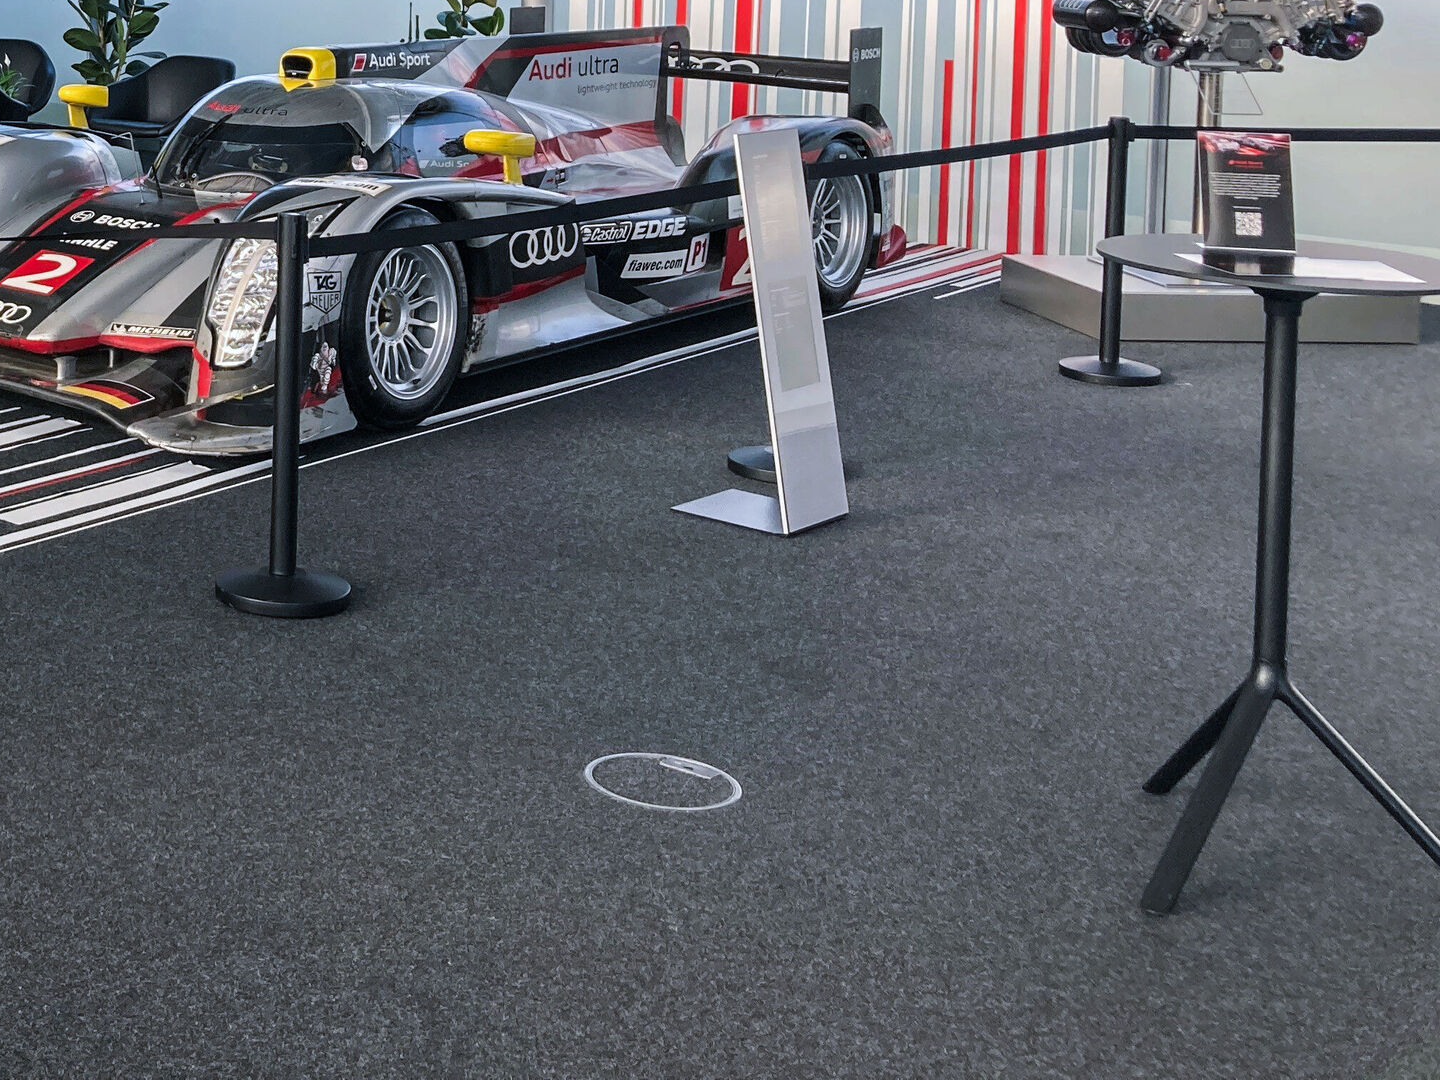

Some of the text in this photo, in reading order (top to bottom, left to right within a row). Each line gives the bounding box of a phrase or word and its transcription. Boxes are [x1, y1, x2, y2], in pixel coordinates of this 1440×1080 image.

[369, 52, 431, 69] Audi Sport
[861, 48, 880, 60] BOSCH
[528, 55, 619, 81] Audi ultra
[577, 80, 656, 96] lightweight technology
[208, 101, 288, 117] Audi ultra
[430, 159, 455, 168] Audi
[591, 217, 687, 242] Castrol EDGE
[691, 238, 707, 266] P1
[628, 257, 683, 272] fiawec.com
[1, 253, 77, 294] 2
[313, 274, 337, 291] TAG
[311, 293, 340, 311] HEUER
[127, 325, 192, 337] MICHELIN
